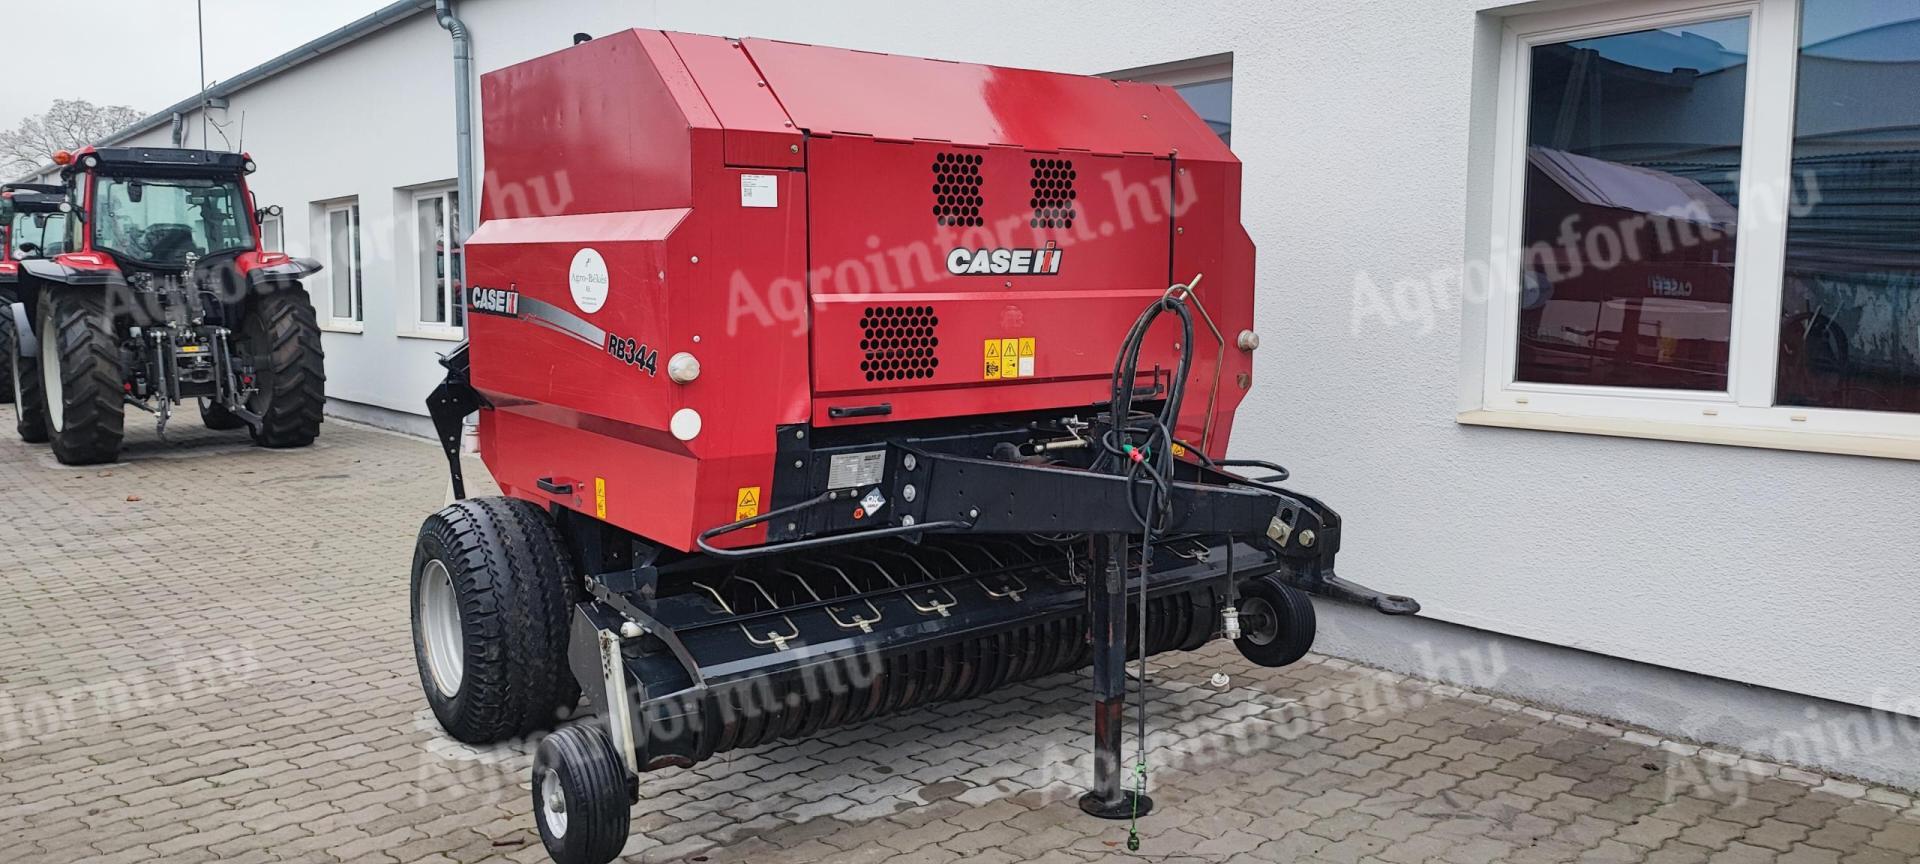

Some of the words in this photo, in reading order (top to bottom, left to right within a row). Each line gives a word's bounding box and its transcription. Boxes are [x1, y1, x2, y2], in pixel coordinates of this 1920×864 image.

[947, 248, 1033, 274] CASE
[471, 286, 506, 313] CASE
[607, 334, 658, 376] RB344
